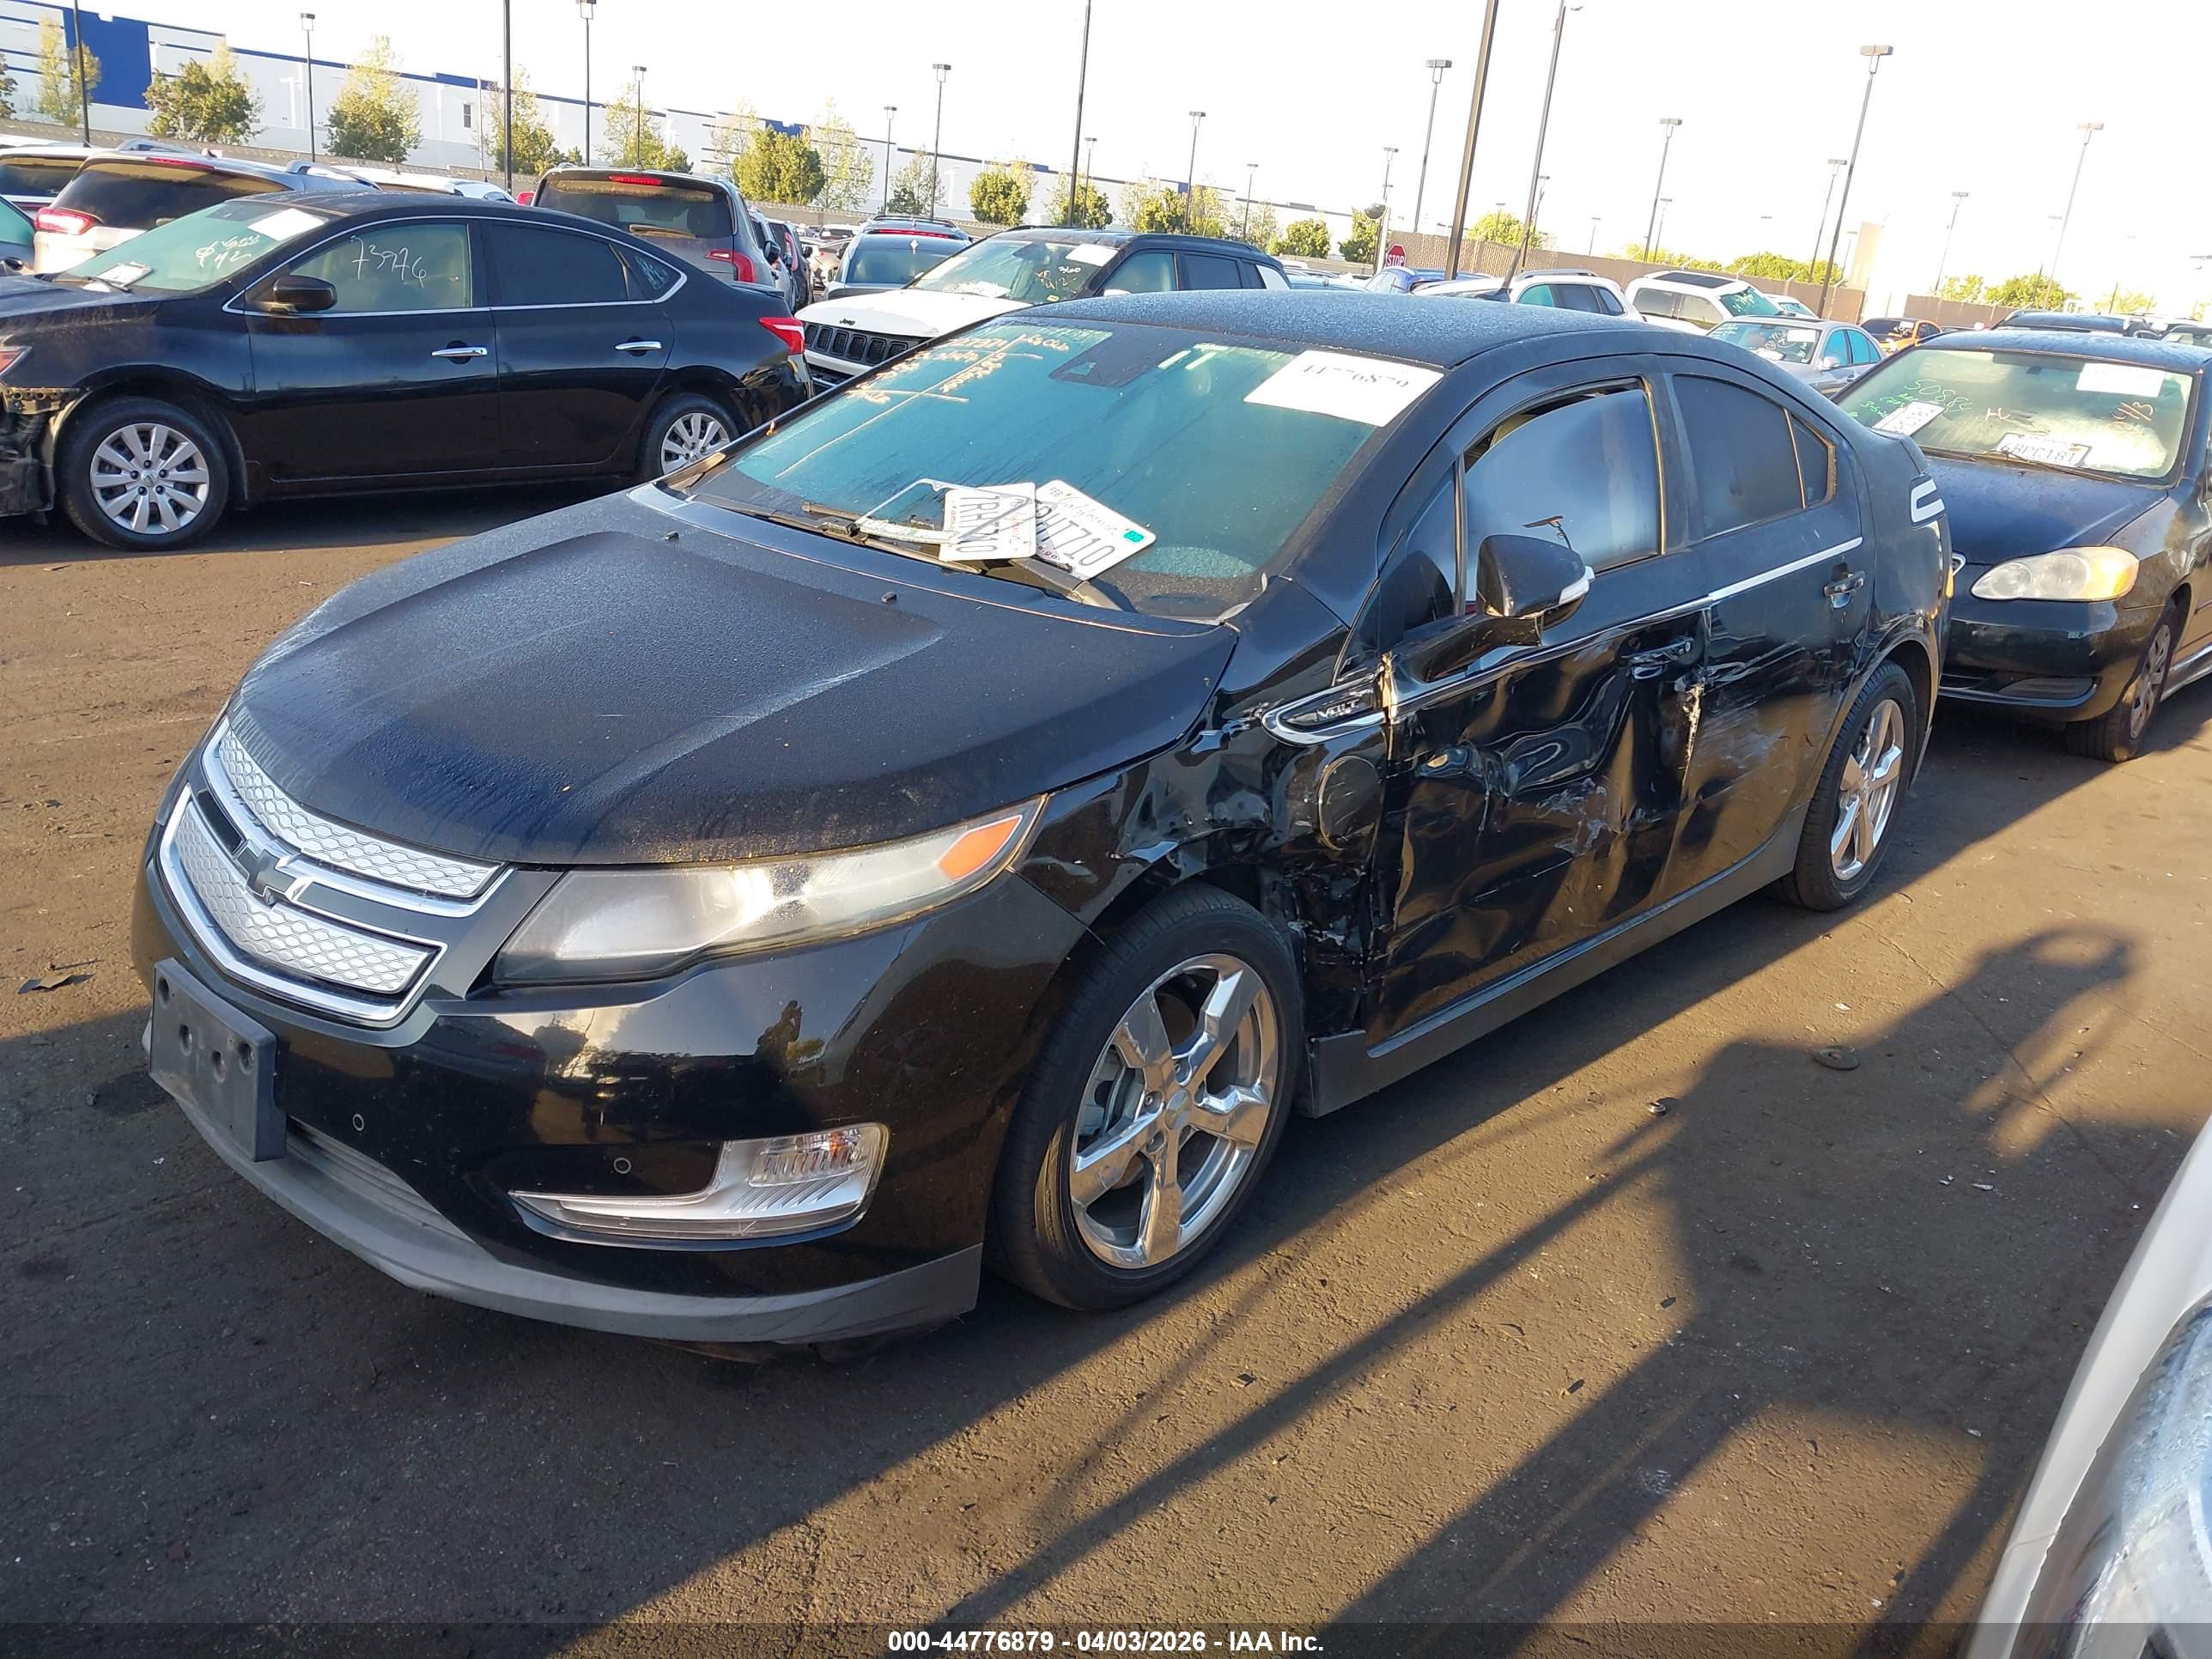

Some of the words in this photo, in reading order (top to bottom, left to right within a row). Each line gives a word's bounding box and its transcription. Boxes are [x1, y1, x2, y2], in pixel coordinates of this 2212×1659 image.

[1387, 254, 1405, 266] STOP
[839, 317, 856, 326] Jeep
[1317, 698, 1360, 718] VOLT
